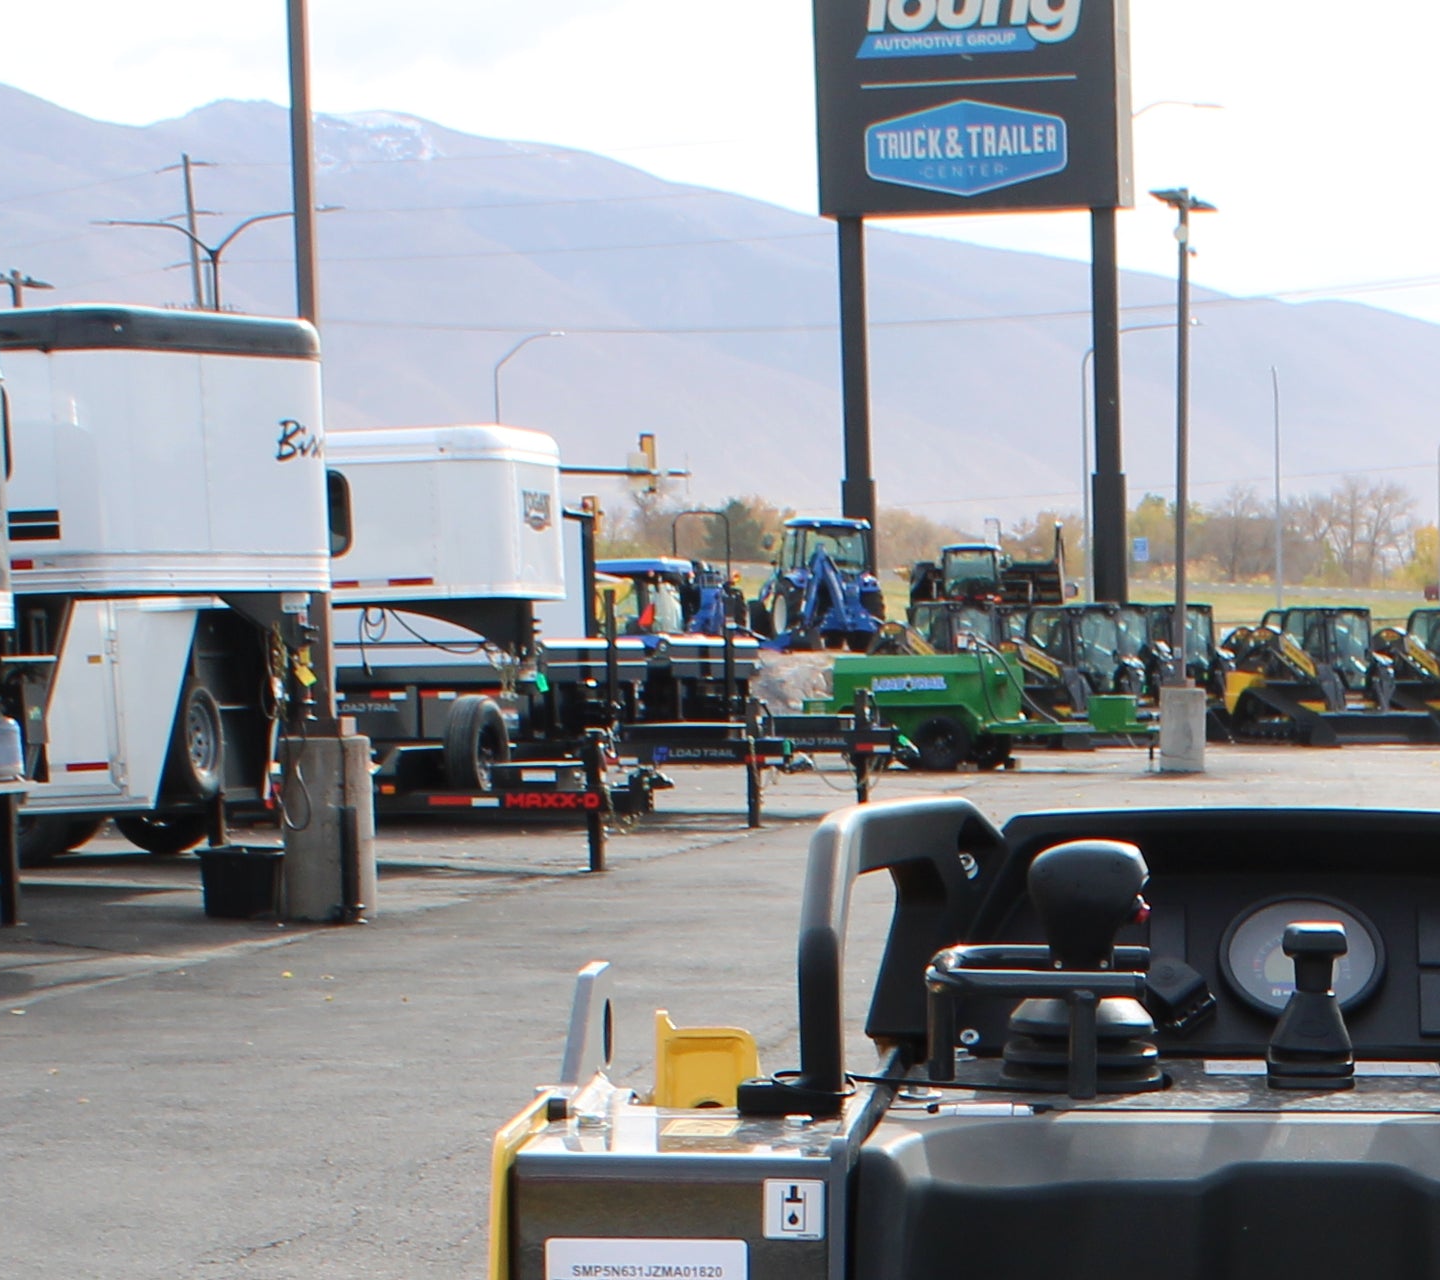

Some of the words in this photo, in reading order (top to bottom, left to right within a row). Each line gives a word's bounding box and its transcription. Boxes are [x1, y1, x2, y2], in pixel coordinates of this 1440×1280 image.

[867, 0, 1083, 43] oung
[874, 34, 963, 51] AUTOMOTIVE
[966, 31, 1017, 47] GROUP
[876, 127, 943, 160] TRUCK
[945, 126, 964, 159] &
[965, 124, 1058, 158] TRAILER
[669, 748, 702, 758] LOAD
[702, 748, 736, 758] TRAIL
[504, 792, 600, 809] MAXX-D
